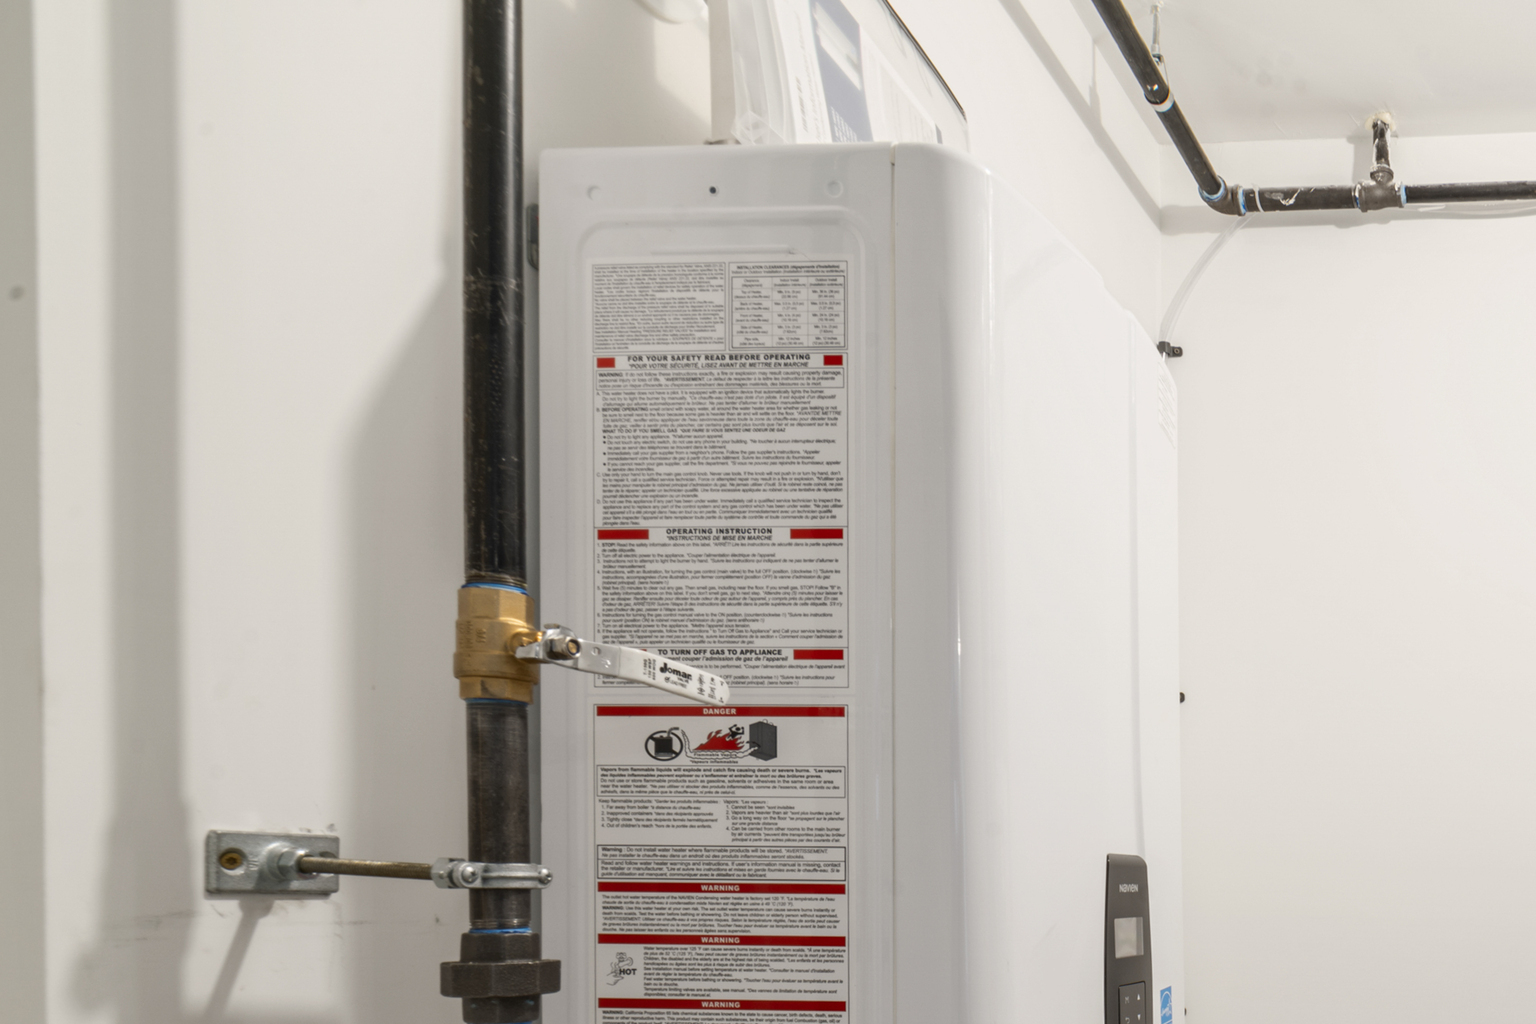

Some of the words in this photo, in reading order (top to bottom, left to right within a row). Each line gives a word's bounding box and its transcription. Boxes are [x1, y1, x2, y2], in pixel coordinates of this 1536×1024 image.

[728, 352, 760, 361] BEFORE
[763, 352, 811, 360] OPERATING
[669, 361, 700, 370] SÉCURITÉ,
[748, 361, 773, 369] METTRE
[782, 361, 808, 369] MARCHE
[619, 967, 637, 976] HOT
